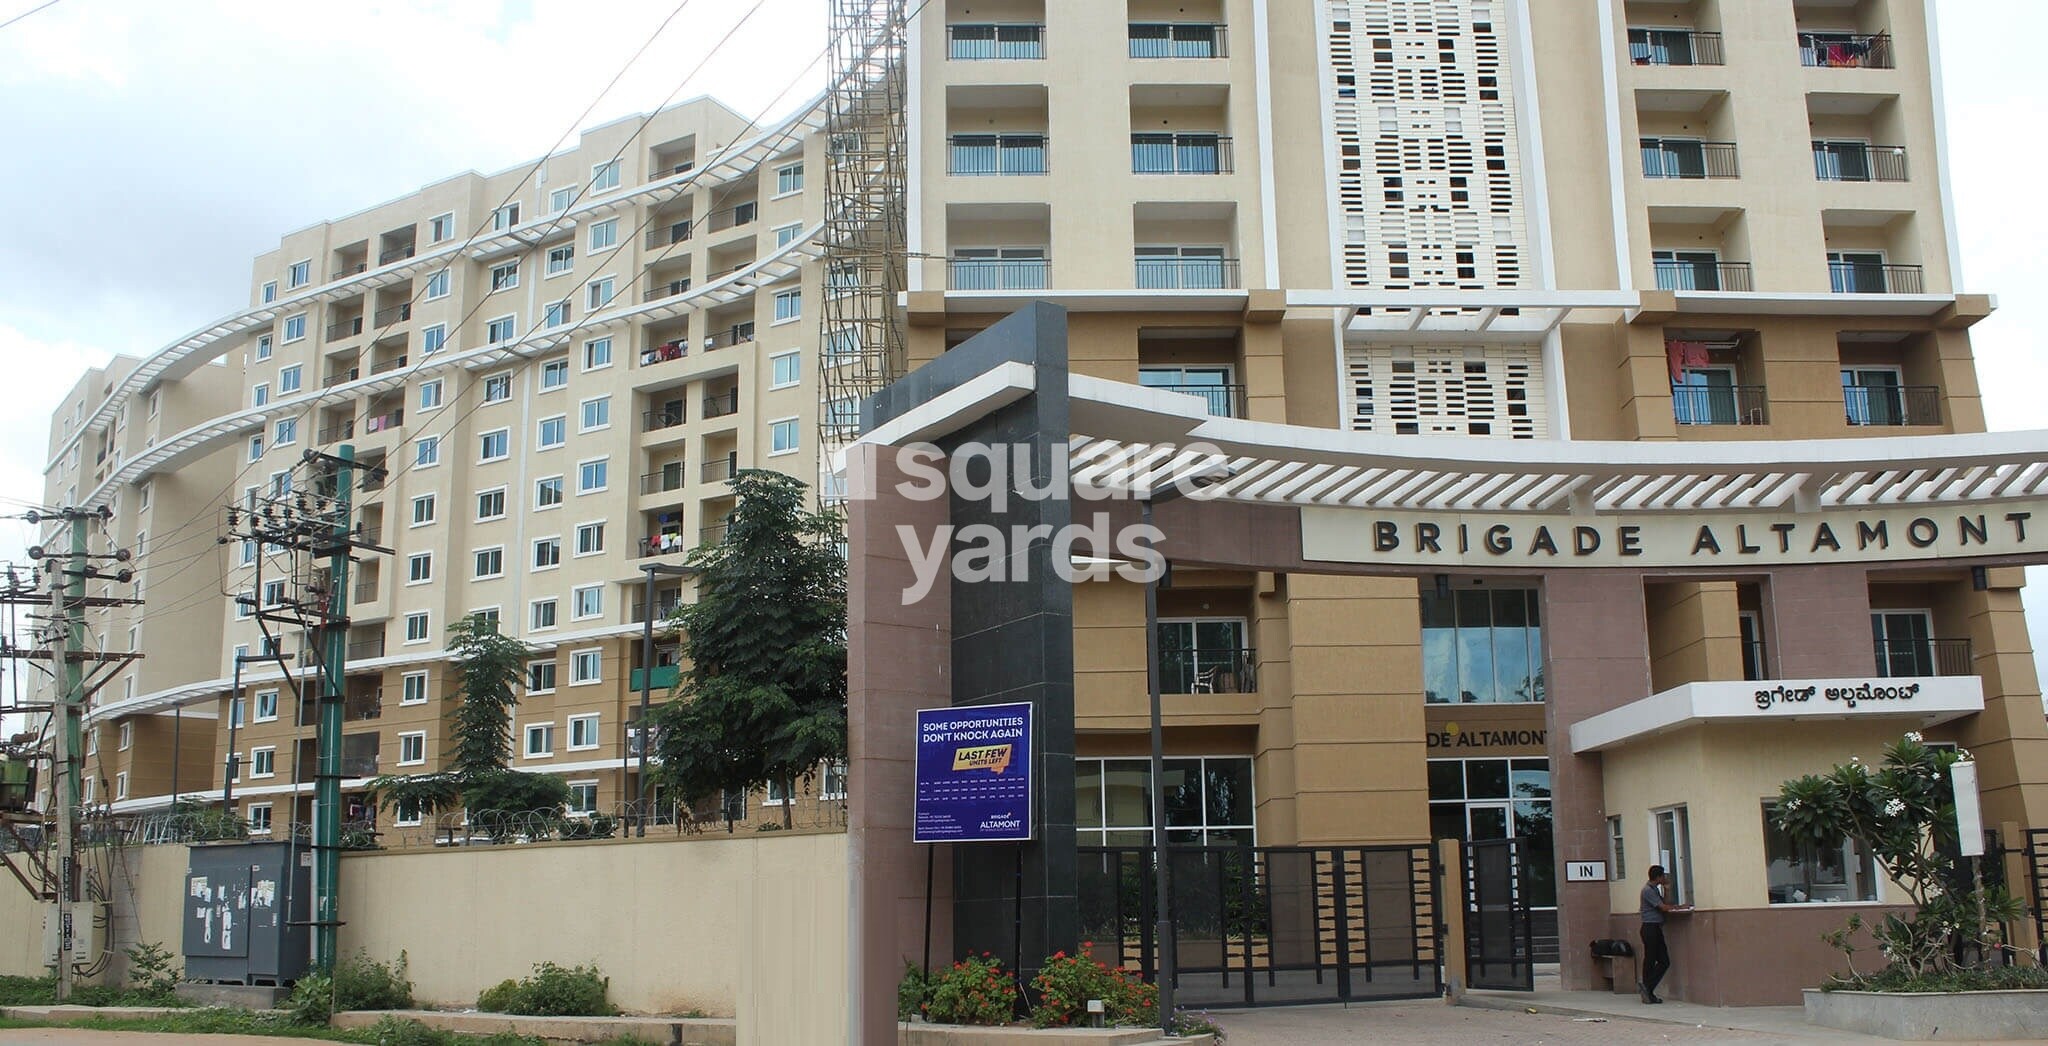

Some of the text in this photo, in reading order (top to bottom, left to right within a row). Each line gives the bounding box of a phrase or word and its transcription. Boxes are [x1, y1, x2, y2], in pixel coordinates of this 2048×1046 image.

[1373, 512, 2031, 556] BRIGADE ALTAMONT
[923, 717, 1023, 732] SOME OPPORTUNITIES
[923, 728, 1023, 743] DON'T KNOCK AGAIN
[1457, 730, 1547, 747] ALTAMON
[958, 748, 1007, 761] LAST FEW
[980, 820, 1021, 828] ALTAMONT
[1580, 865, 1593, 877] IN
